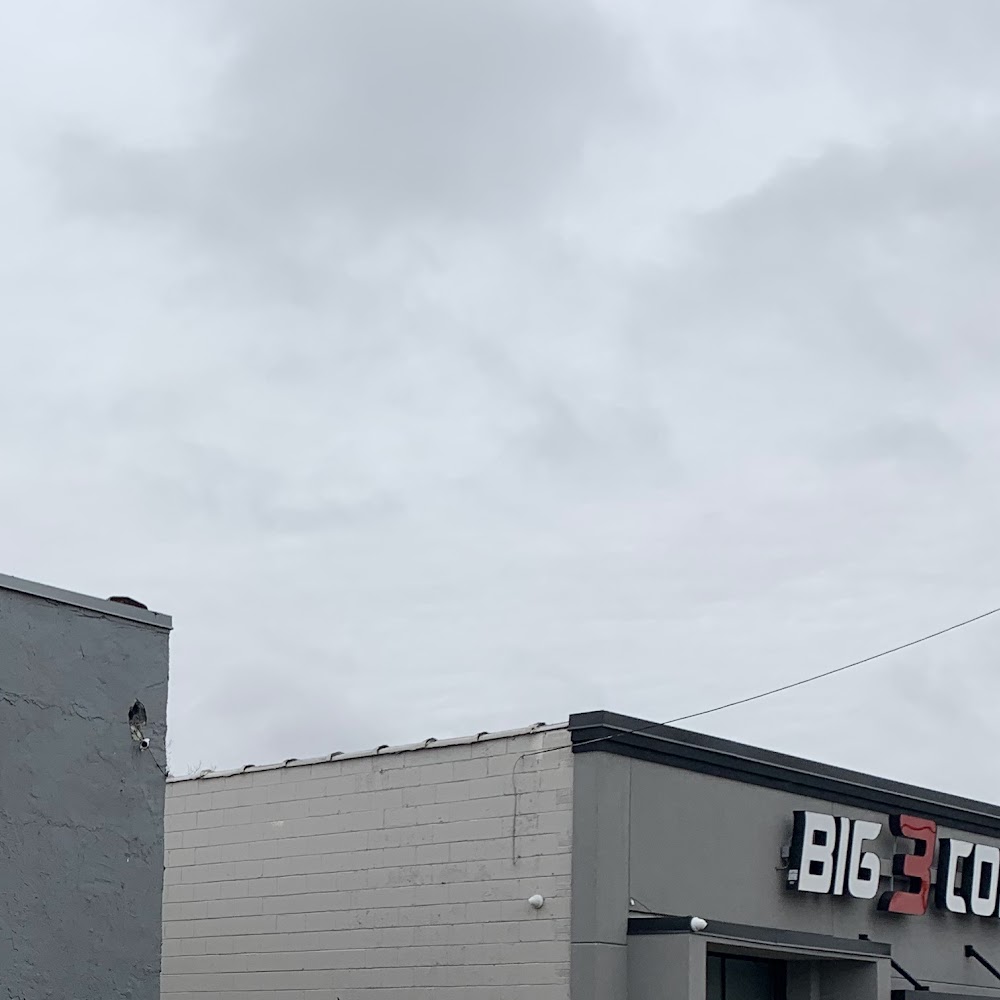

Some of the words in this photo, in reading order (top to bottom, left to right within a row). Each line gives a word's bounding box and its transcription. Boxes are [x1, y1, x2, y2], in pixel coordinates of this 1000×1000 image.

[797, 810, 883, 900] BIG
[888, 813, 937, 916] 3
[945, 837, 1000, 918] CO
